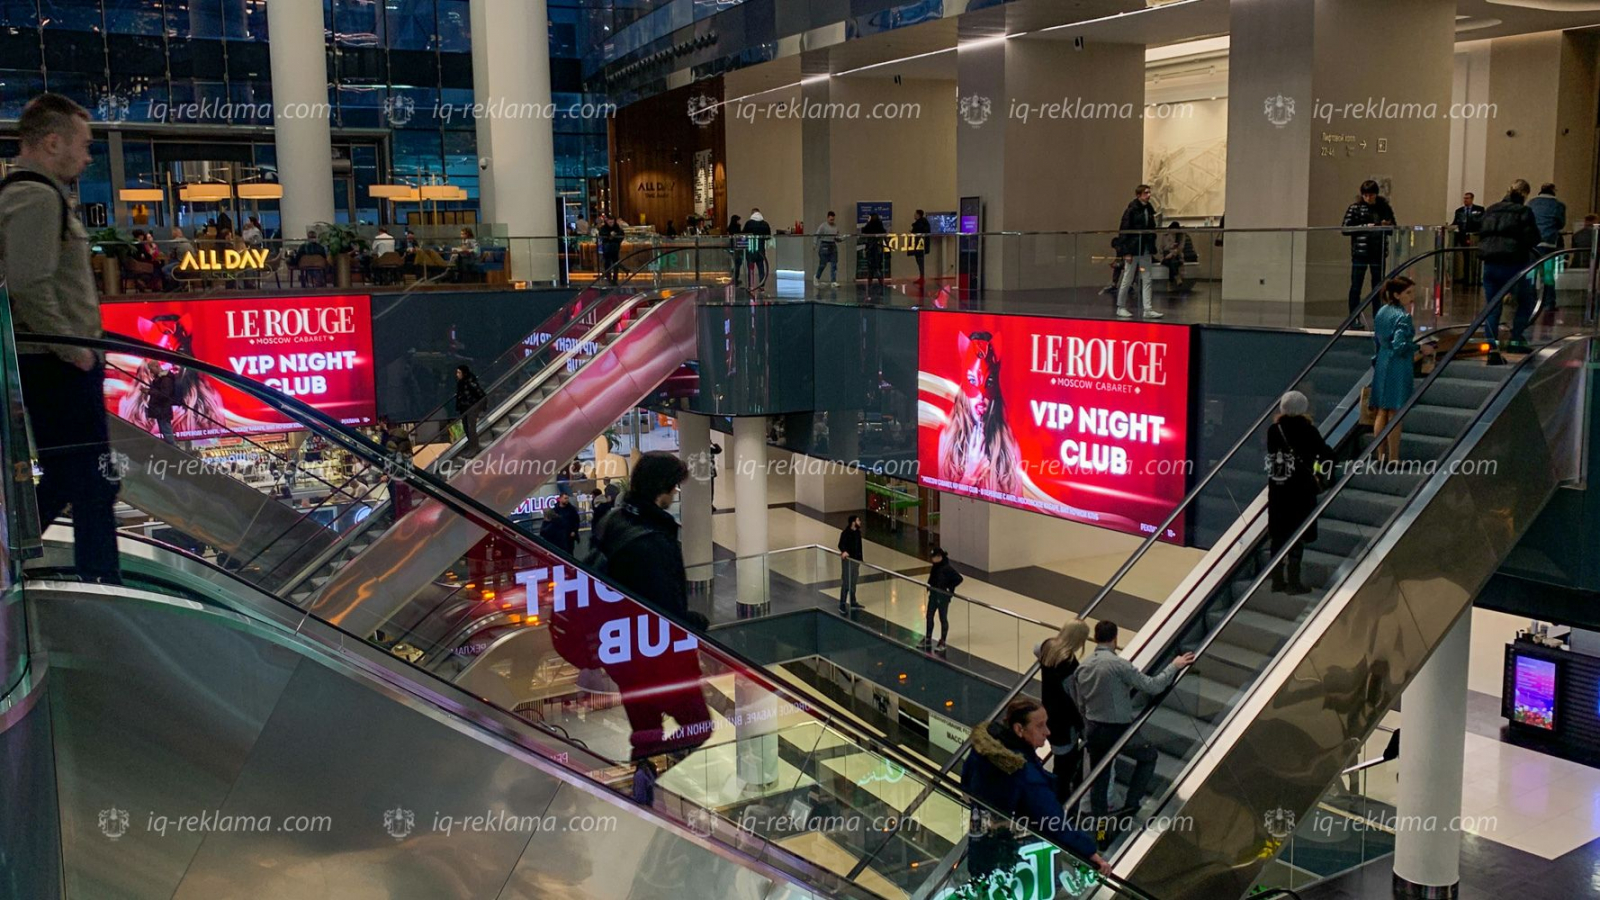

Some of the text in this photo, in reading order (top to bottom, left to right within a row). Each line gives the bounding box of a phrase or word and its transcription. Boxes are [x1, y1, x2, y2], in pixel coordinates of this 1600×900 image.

[179, 249, 269, 270] ALL DAY
[225, 306, 356, 339] LE ROUGE
[256, 335, 327, 345] MOSCOW CABARET
[229, 351, 356, 375] VIP NIGHT
[1030, 333, 1167, 386] LE ROUGE
[1057, 378, 1133, 394] MOSCOW CABARET
[1030, 400, 1165, 444] VIP NIGHT
[1060, 440, 1127, 475] CLUB
